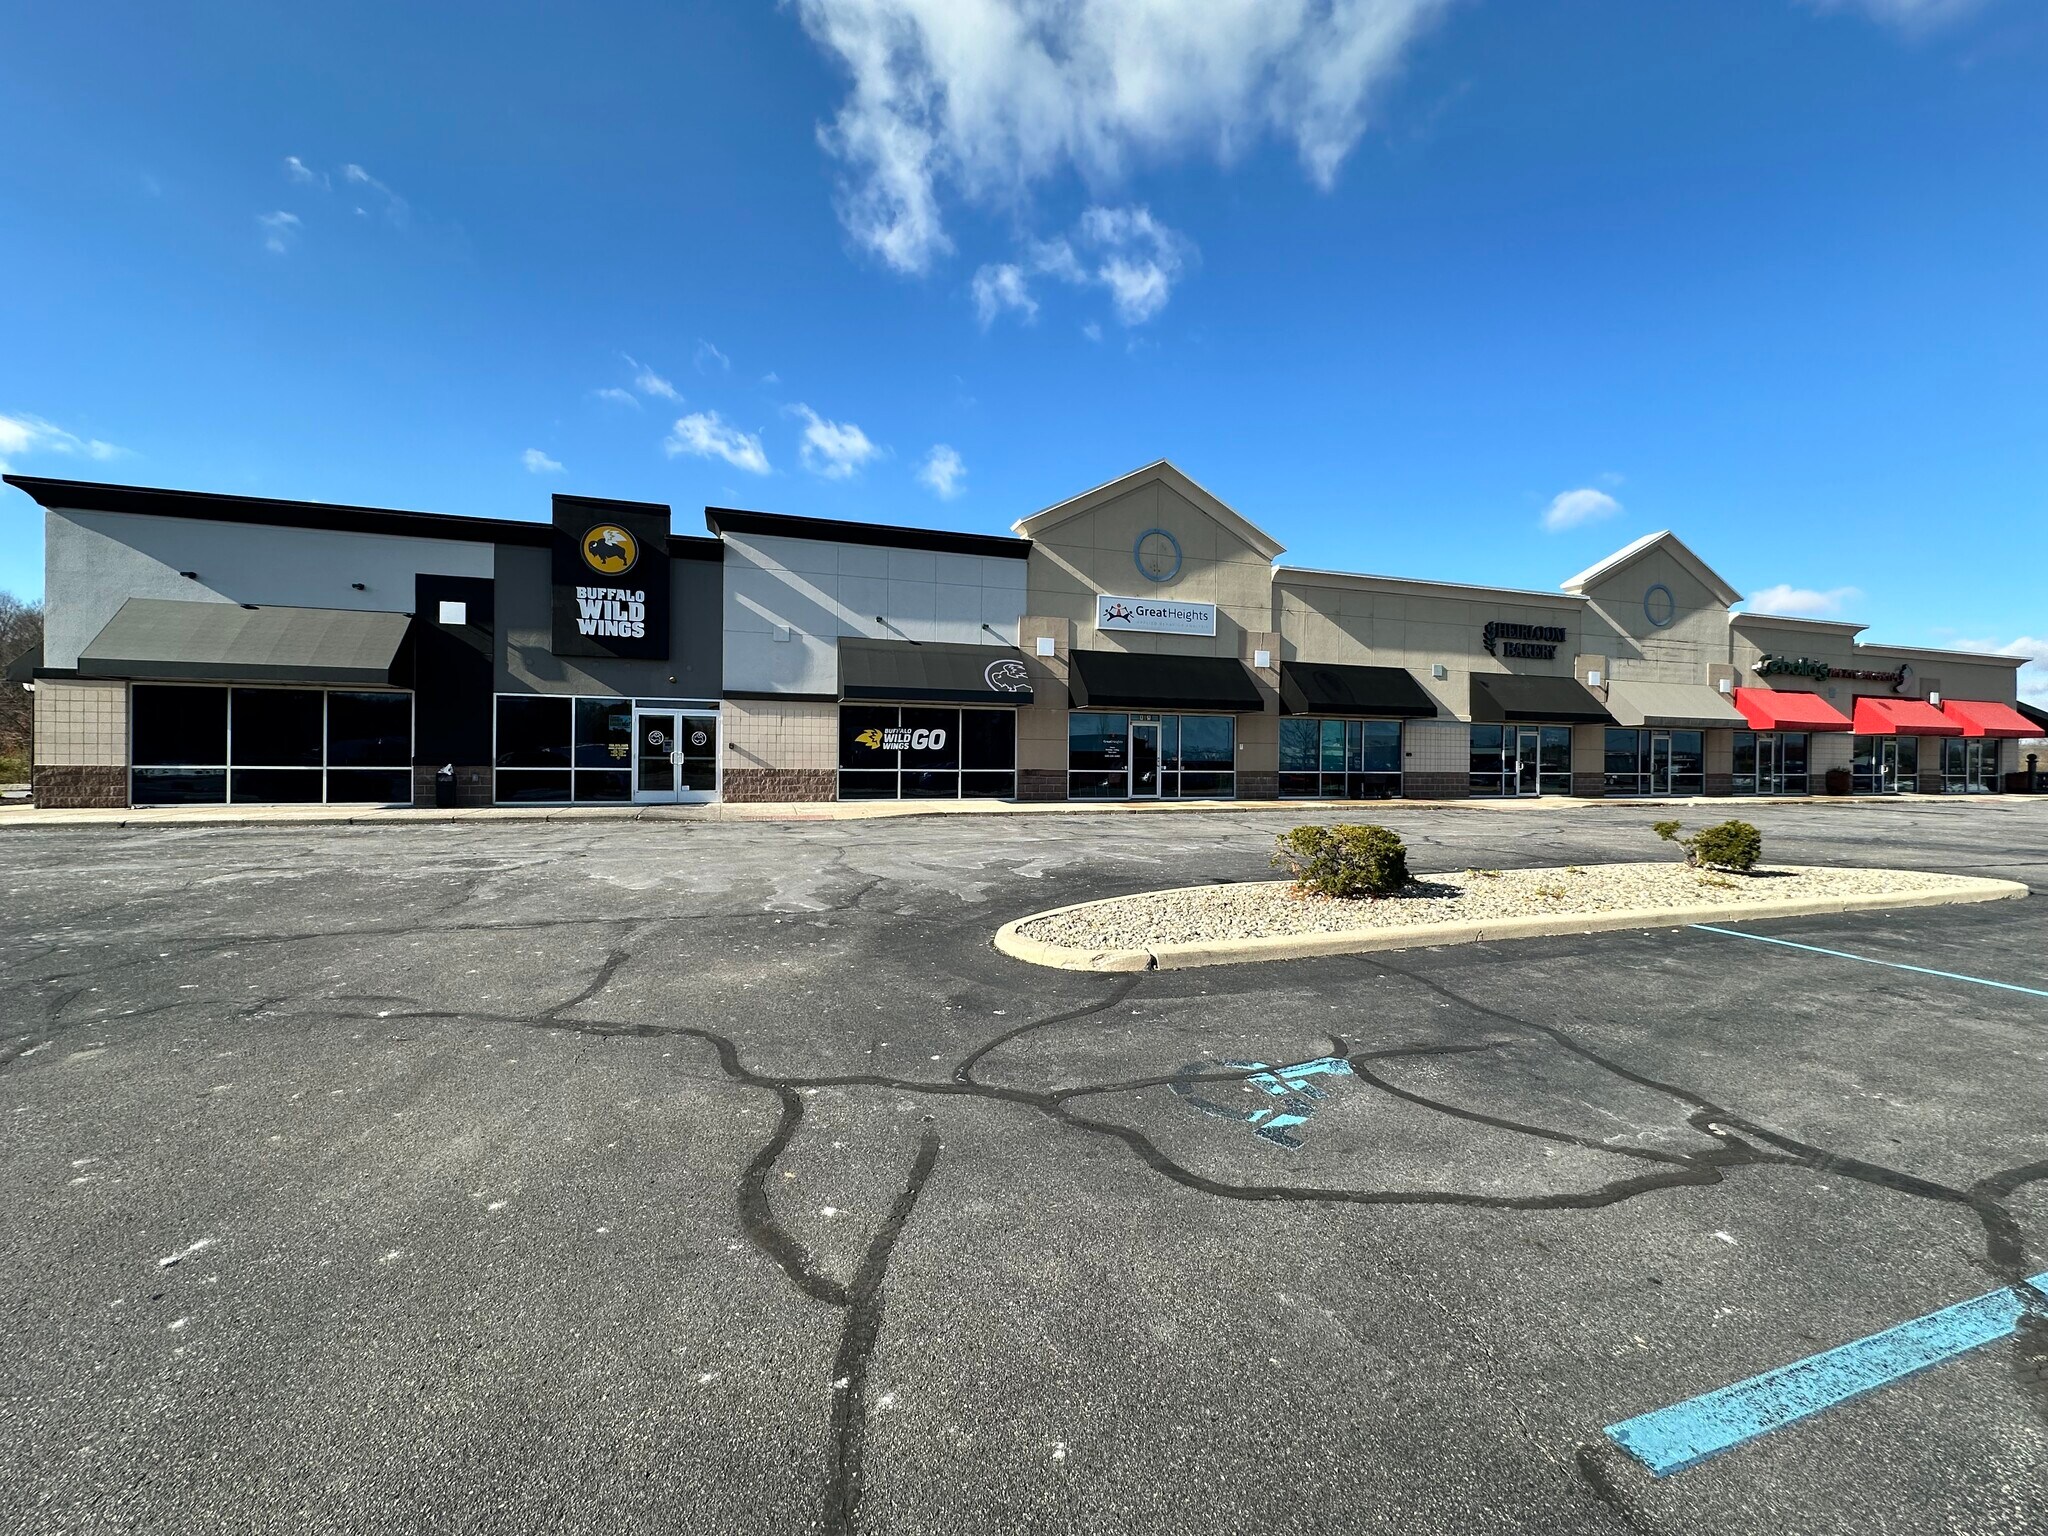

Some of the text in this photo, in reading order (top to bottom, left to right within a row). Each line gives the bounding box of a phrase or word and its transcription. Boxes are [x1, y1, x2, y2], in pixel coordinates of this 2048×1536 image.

[576, 586, 645, 602] BUFFALO
[576, 598, 645, 622] WILD
[576, 618, 645, 638] WINGS
[1495, 622, 1567, 642] HEIRLOOM
[1502, 642, 1558, 660] BAKERY
[882, 742, 910, 750] WINGS
[883, 733, 911, 743] WILD
[911, 728, 947, 750] GO
